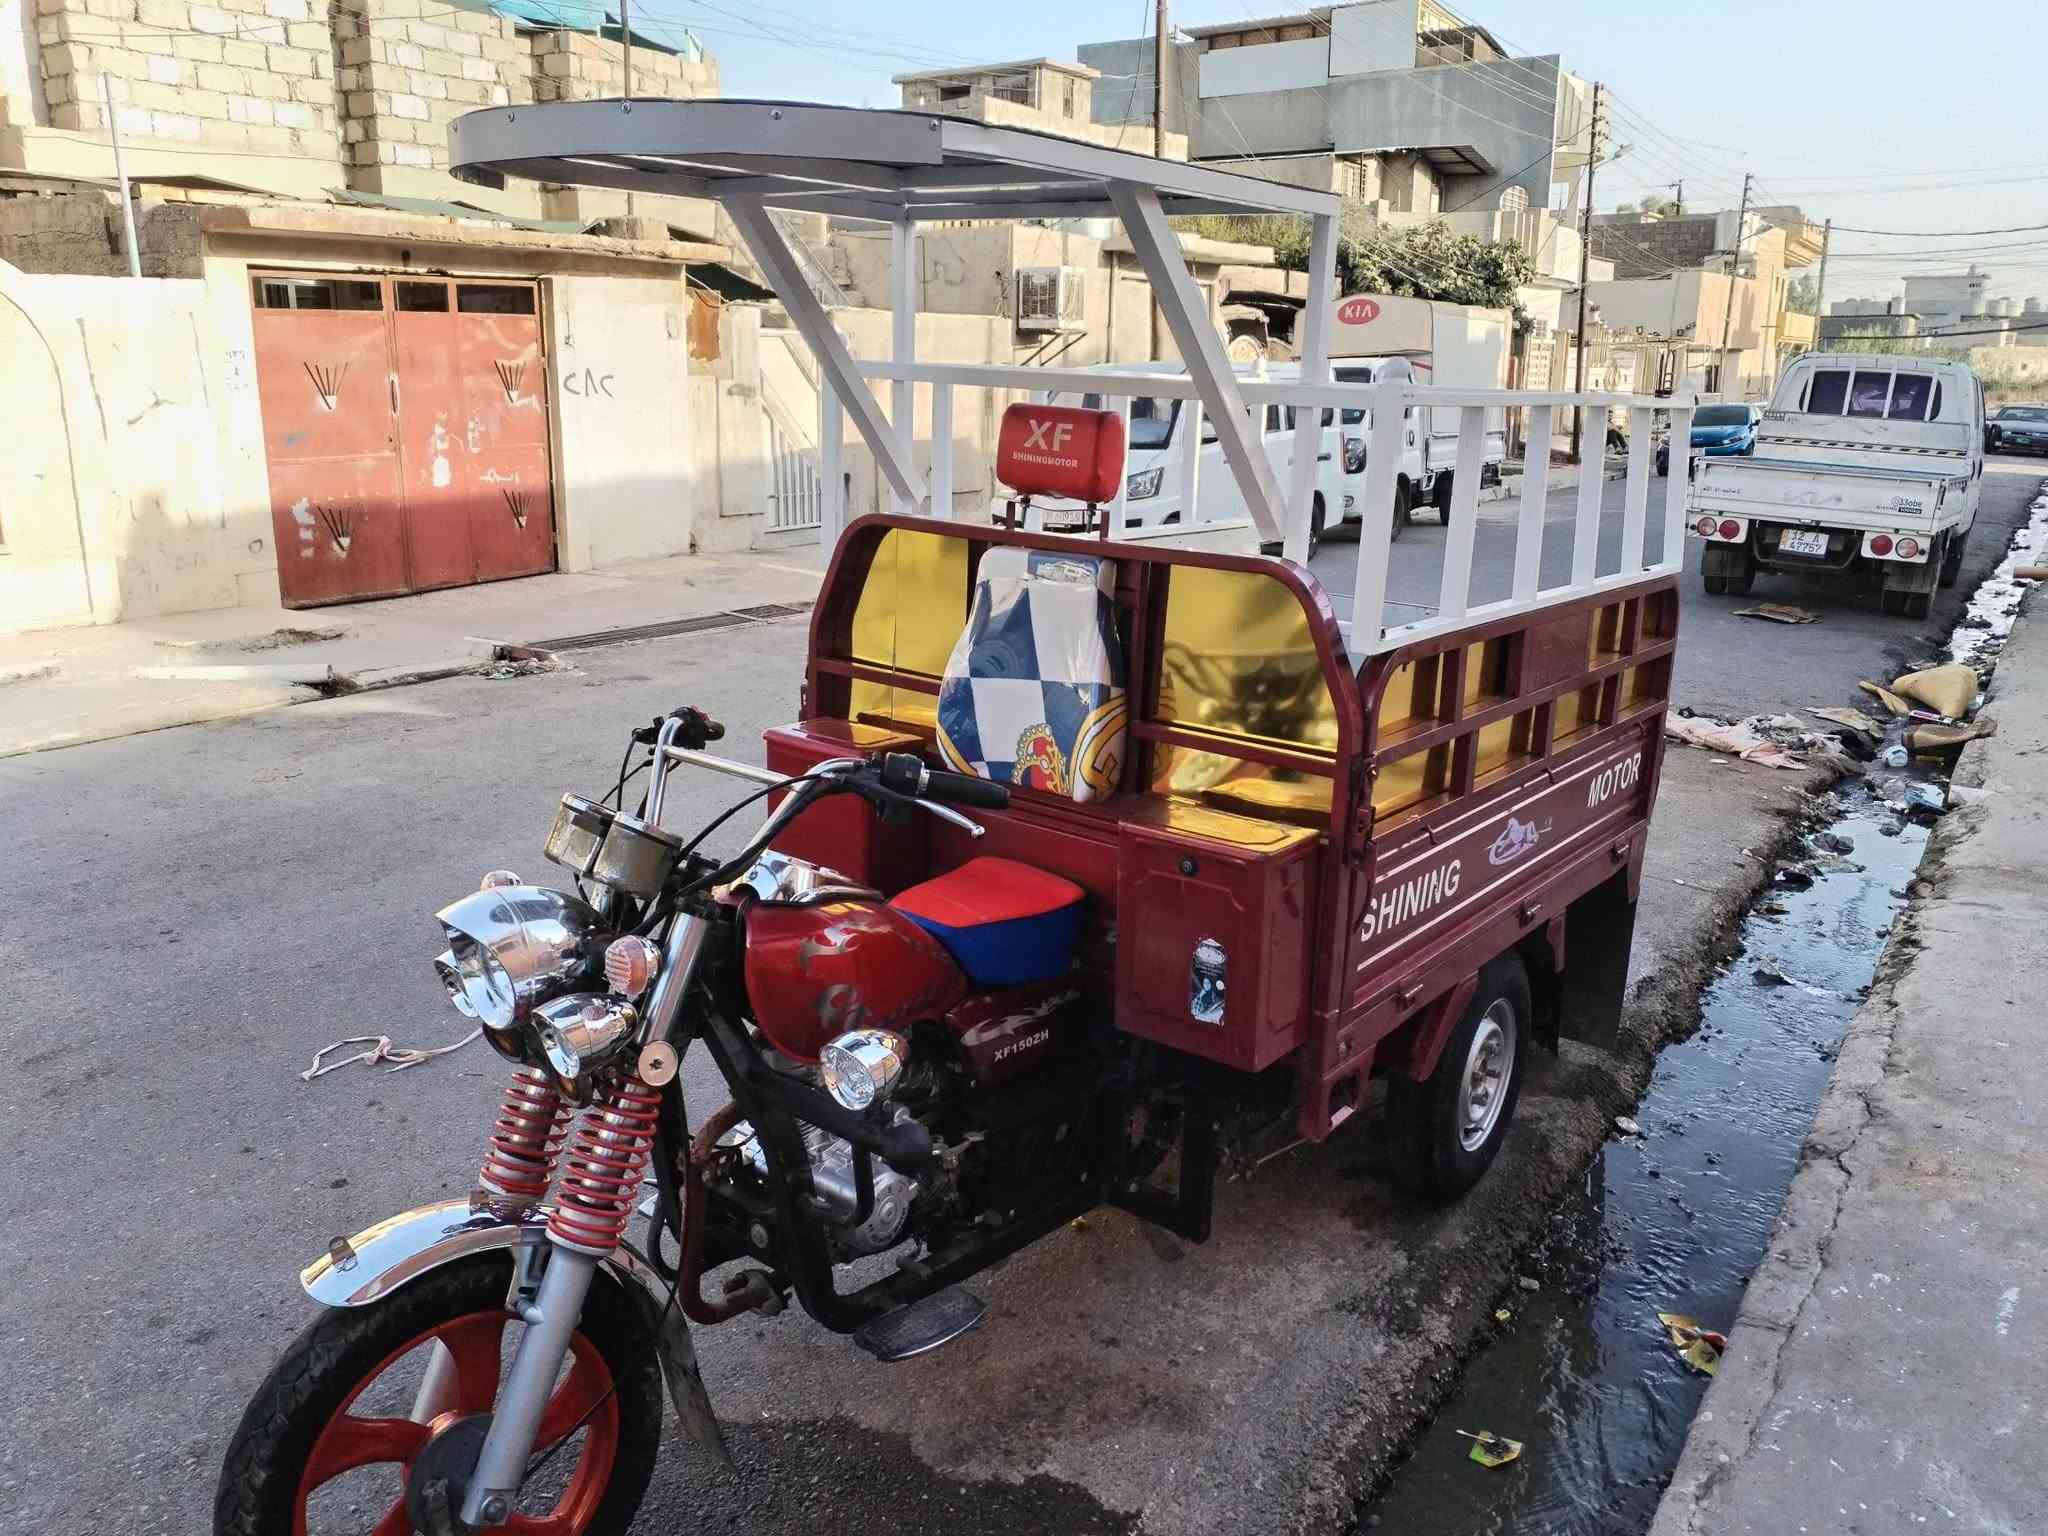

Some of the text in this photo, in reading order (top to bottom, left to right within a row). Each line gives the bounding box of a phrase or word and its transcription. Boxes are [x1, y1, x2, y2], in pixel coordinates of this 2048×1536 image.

[1344, 304, 1372, 318] KIA
[1023, 419, 1074, 451] XF
[1011, 450, 1079, 468] SHININGMOTOR
[1360, 752, 1642, 942] SHINING MOTOR
